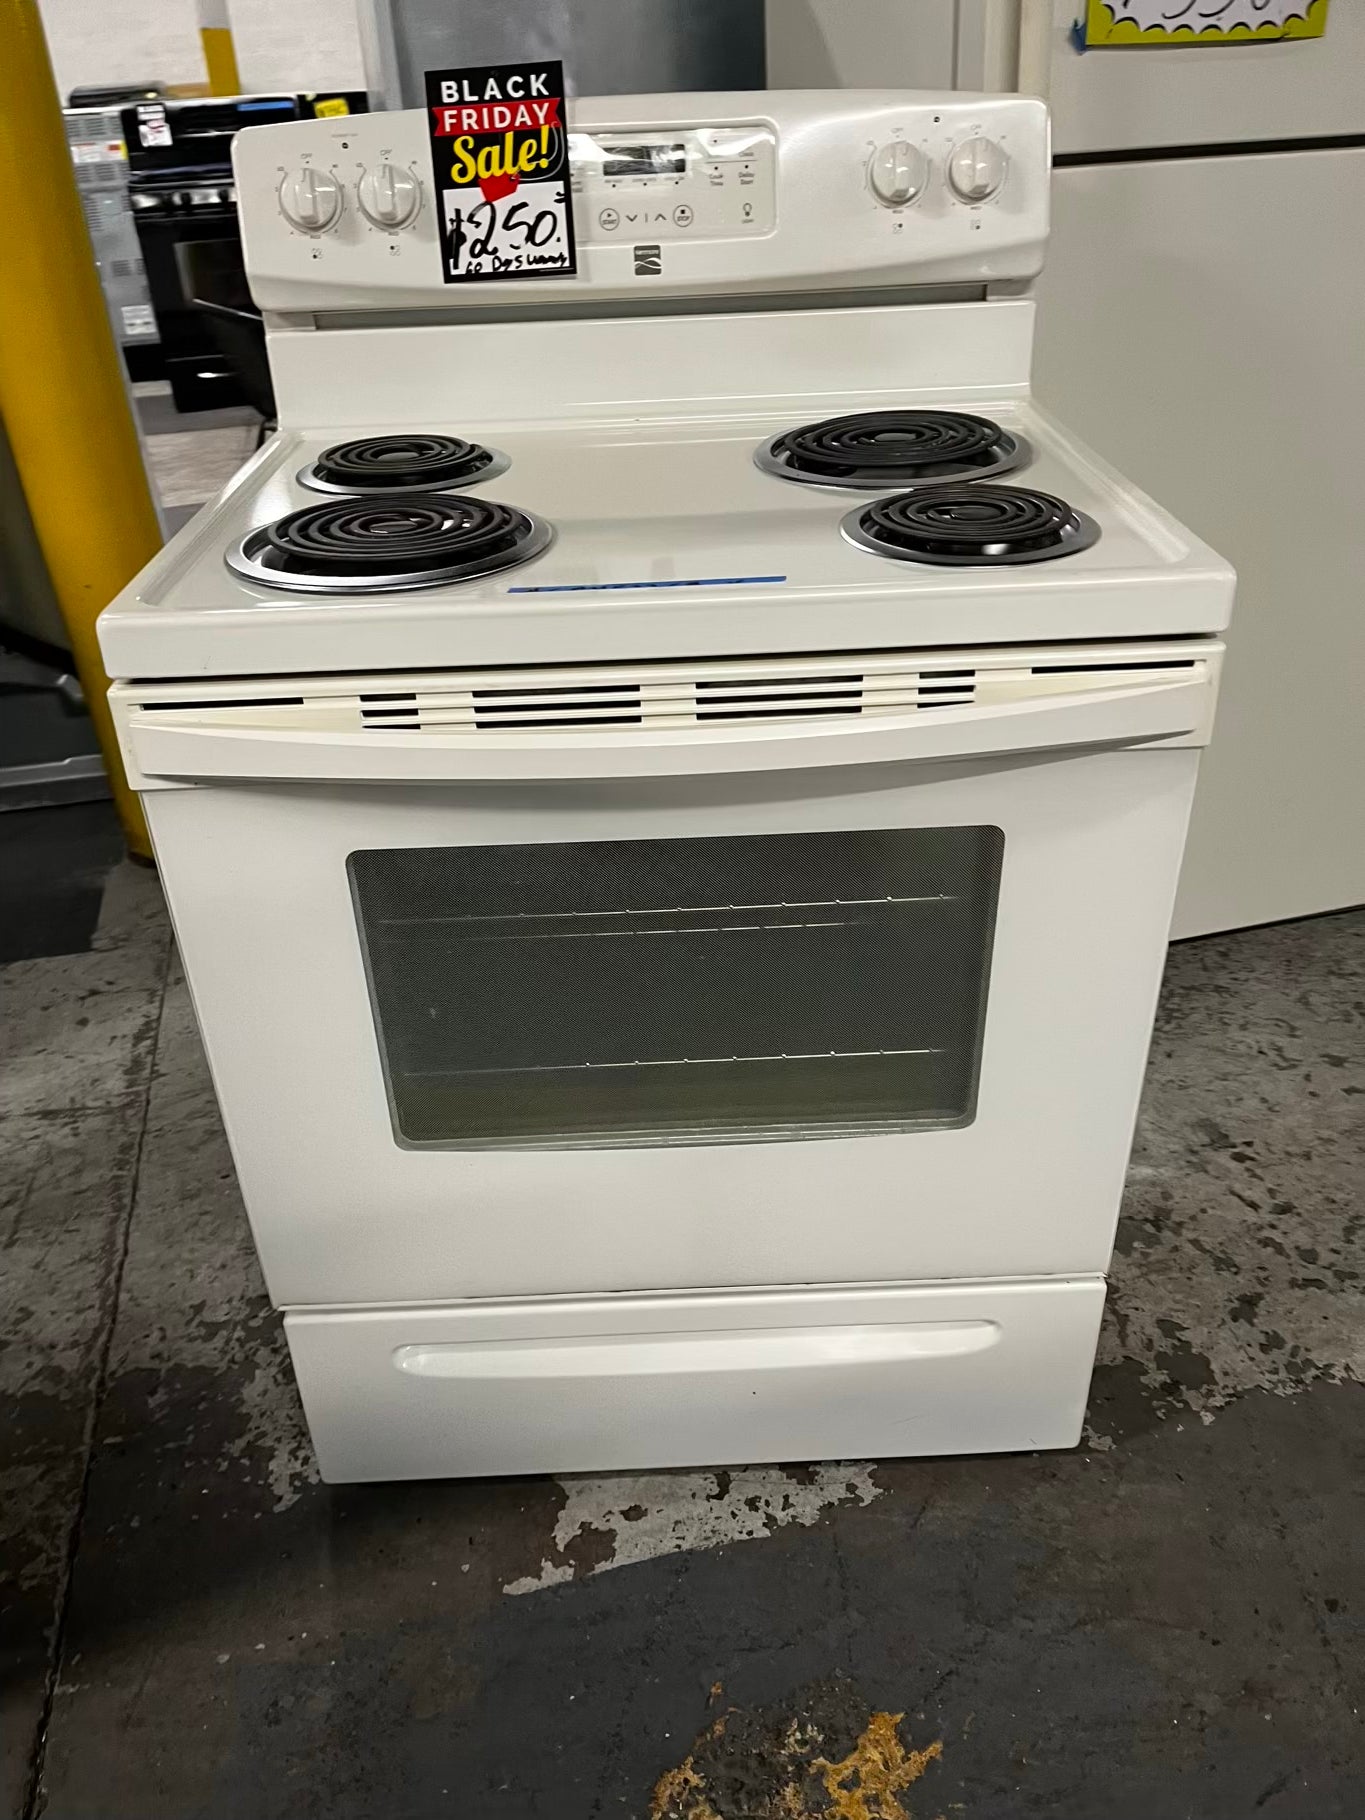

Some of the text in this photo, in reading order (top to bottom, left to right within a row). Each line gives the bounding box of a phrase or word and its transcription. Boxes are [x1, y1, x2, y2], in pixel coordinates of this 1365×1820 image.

[440, 73, 549, 103] BLACK
[443, 103, 549, 132] FRIDAY
[451, 125, 549, 184] Sale!
